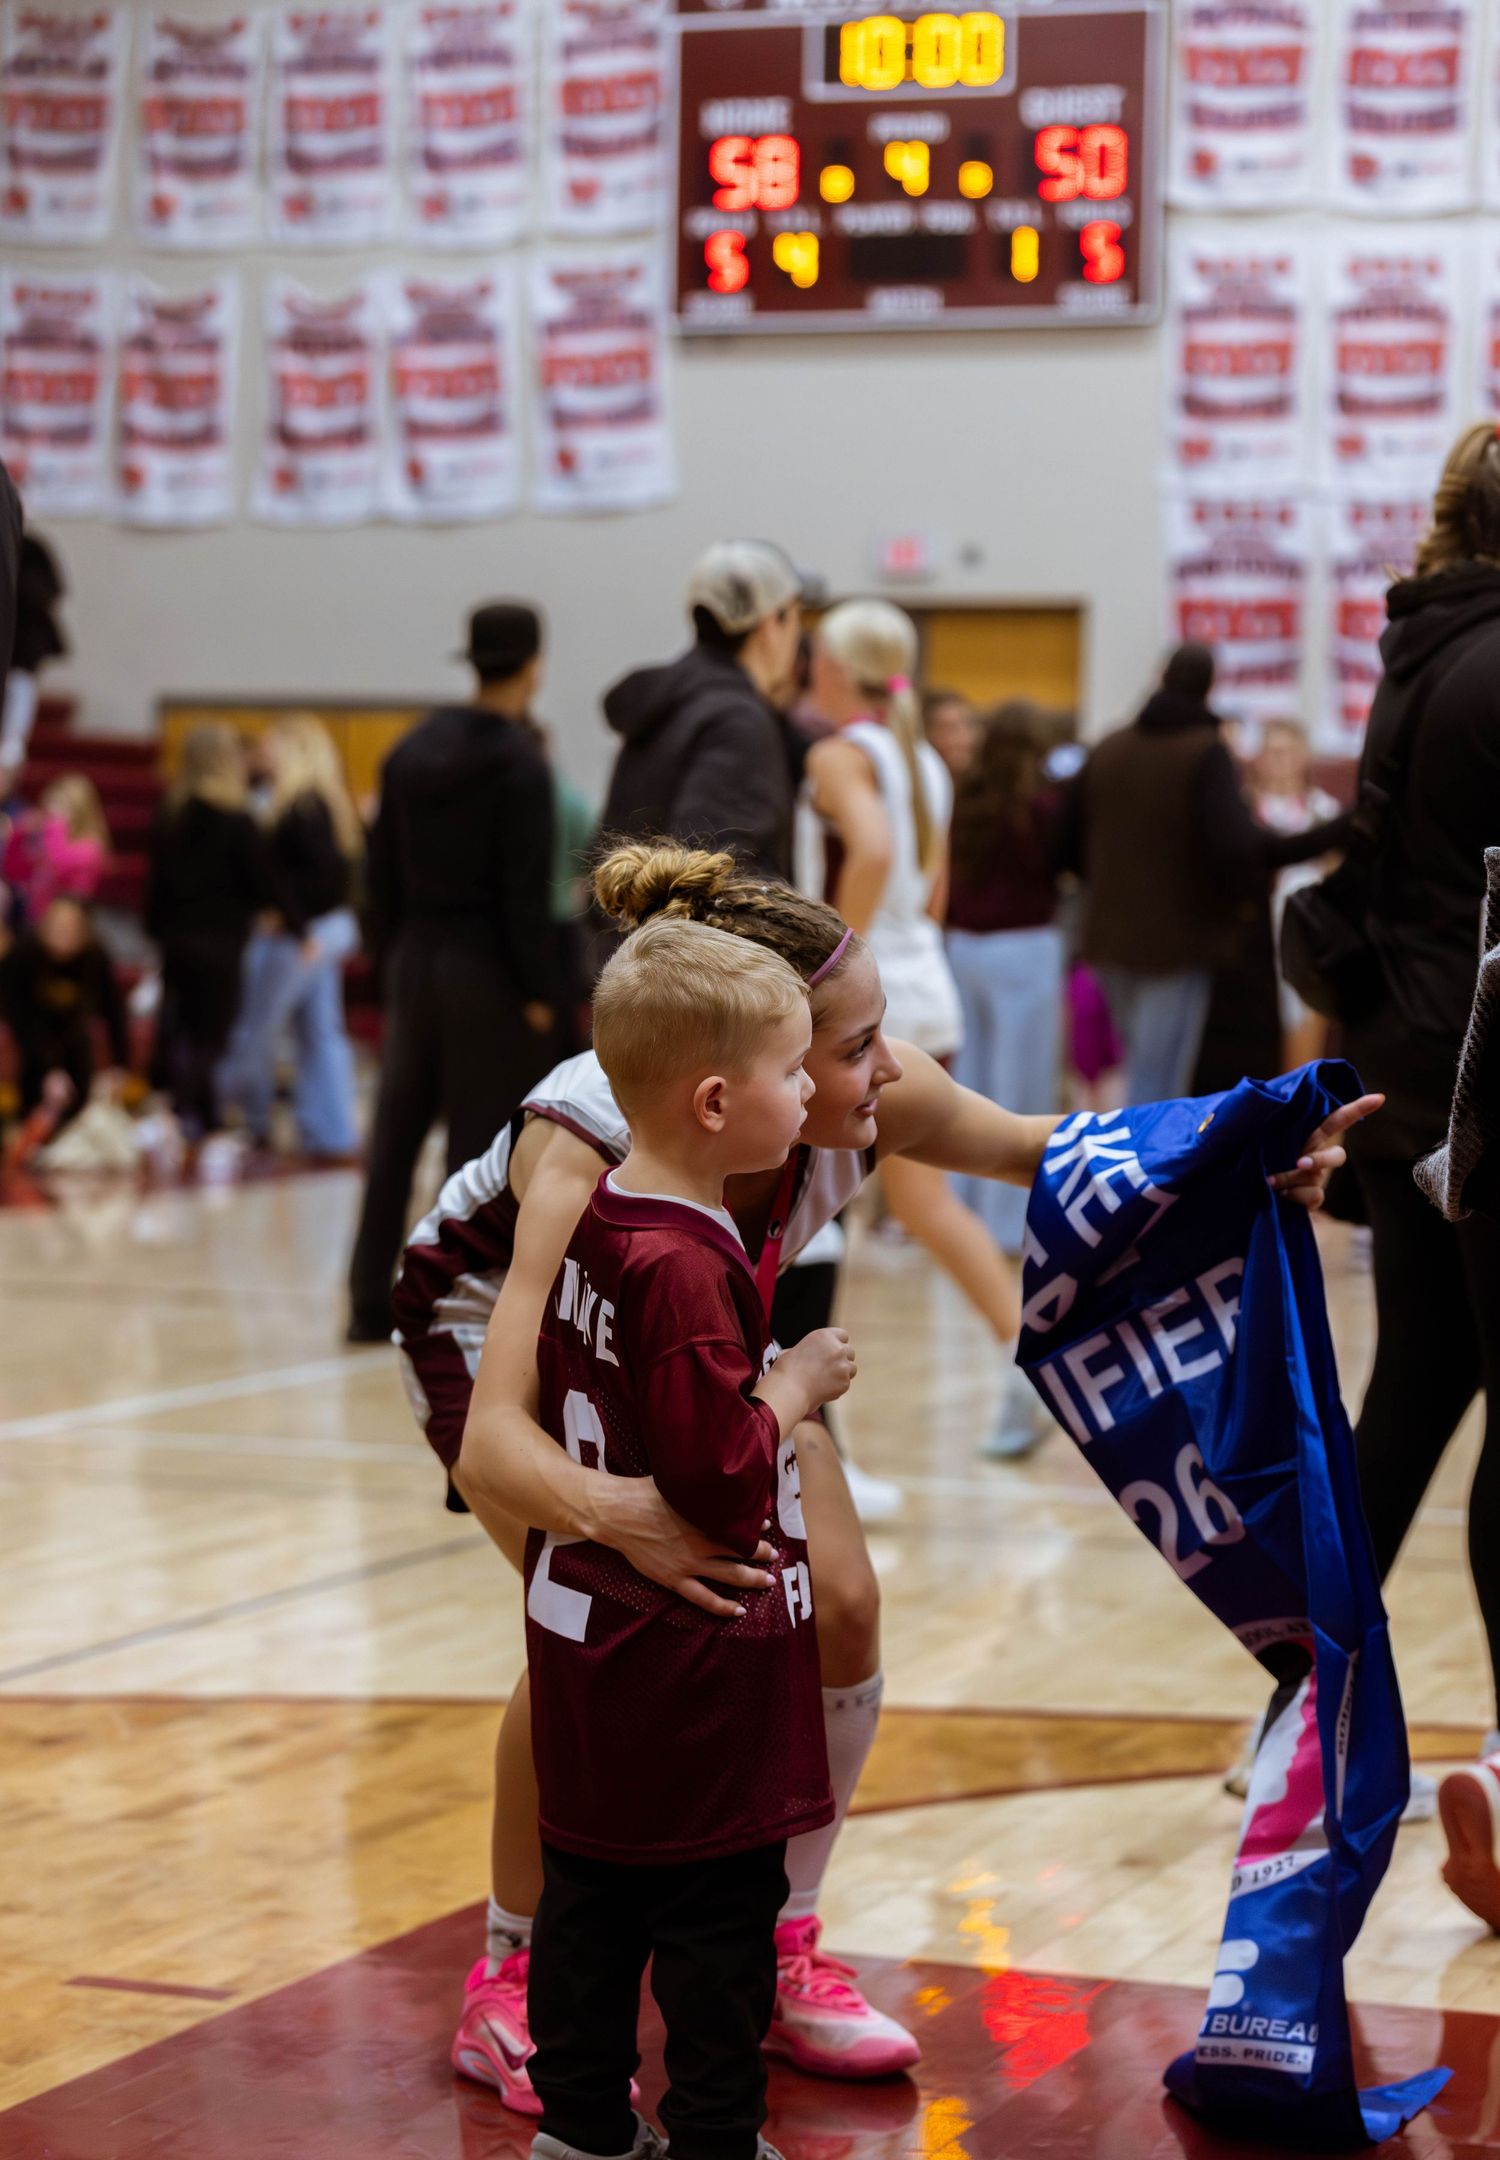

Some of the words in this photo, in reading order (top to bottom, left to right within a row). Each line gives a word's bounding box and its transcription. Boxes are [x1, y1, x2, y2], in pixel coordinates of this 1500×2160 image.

[840, 12, 1005, 90] 10:00
[709, 135, 799, 212] 58
[1034, 124, 1128, 201] 50
[704, 230, 749, 293] 5
[1080, 220, 1125, 284] 5
[1251, 1855, 1296, 1884] 1927
